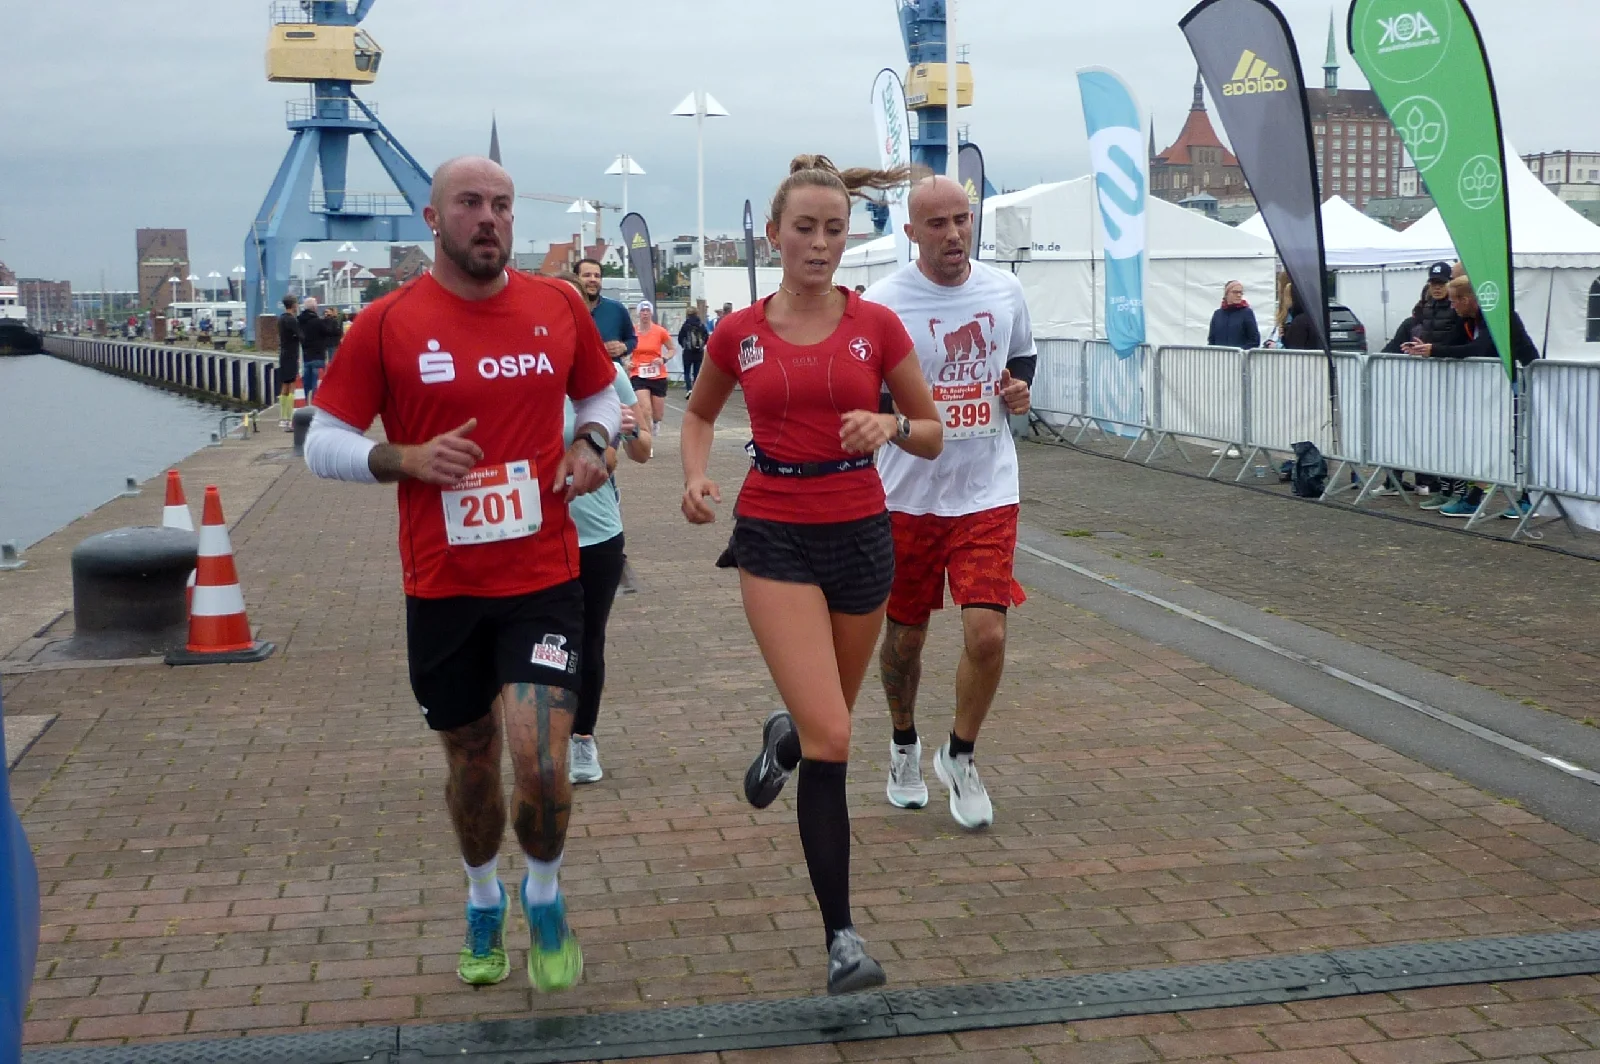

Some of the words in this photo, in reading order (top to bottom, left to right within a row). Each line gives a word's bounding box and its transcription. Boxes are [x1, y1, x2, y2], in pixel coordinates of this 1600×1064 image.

[478, 352, 554, 379] OSPA
[938, 361, 986, 382] GFC
[945, 402, 991, 429] 399
[460, 488, 523, 527] 201
